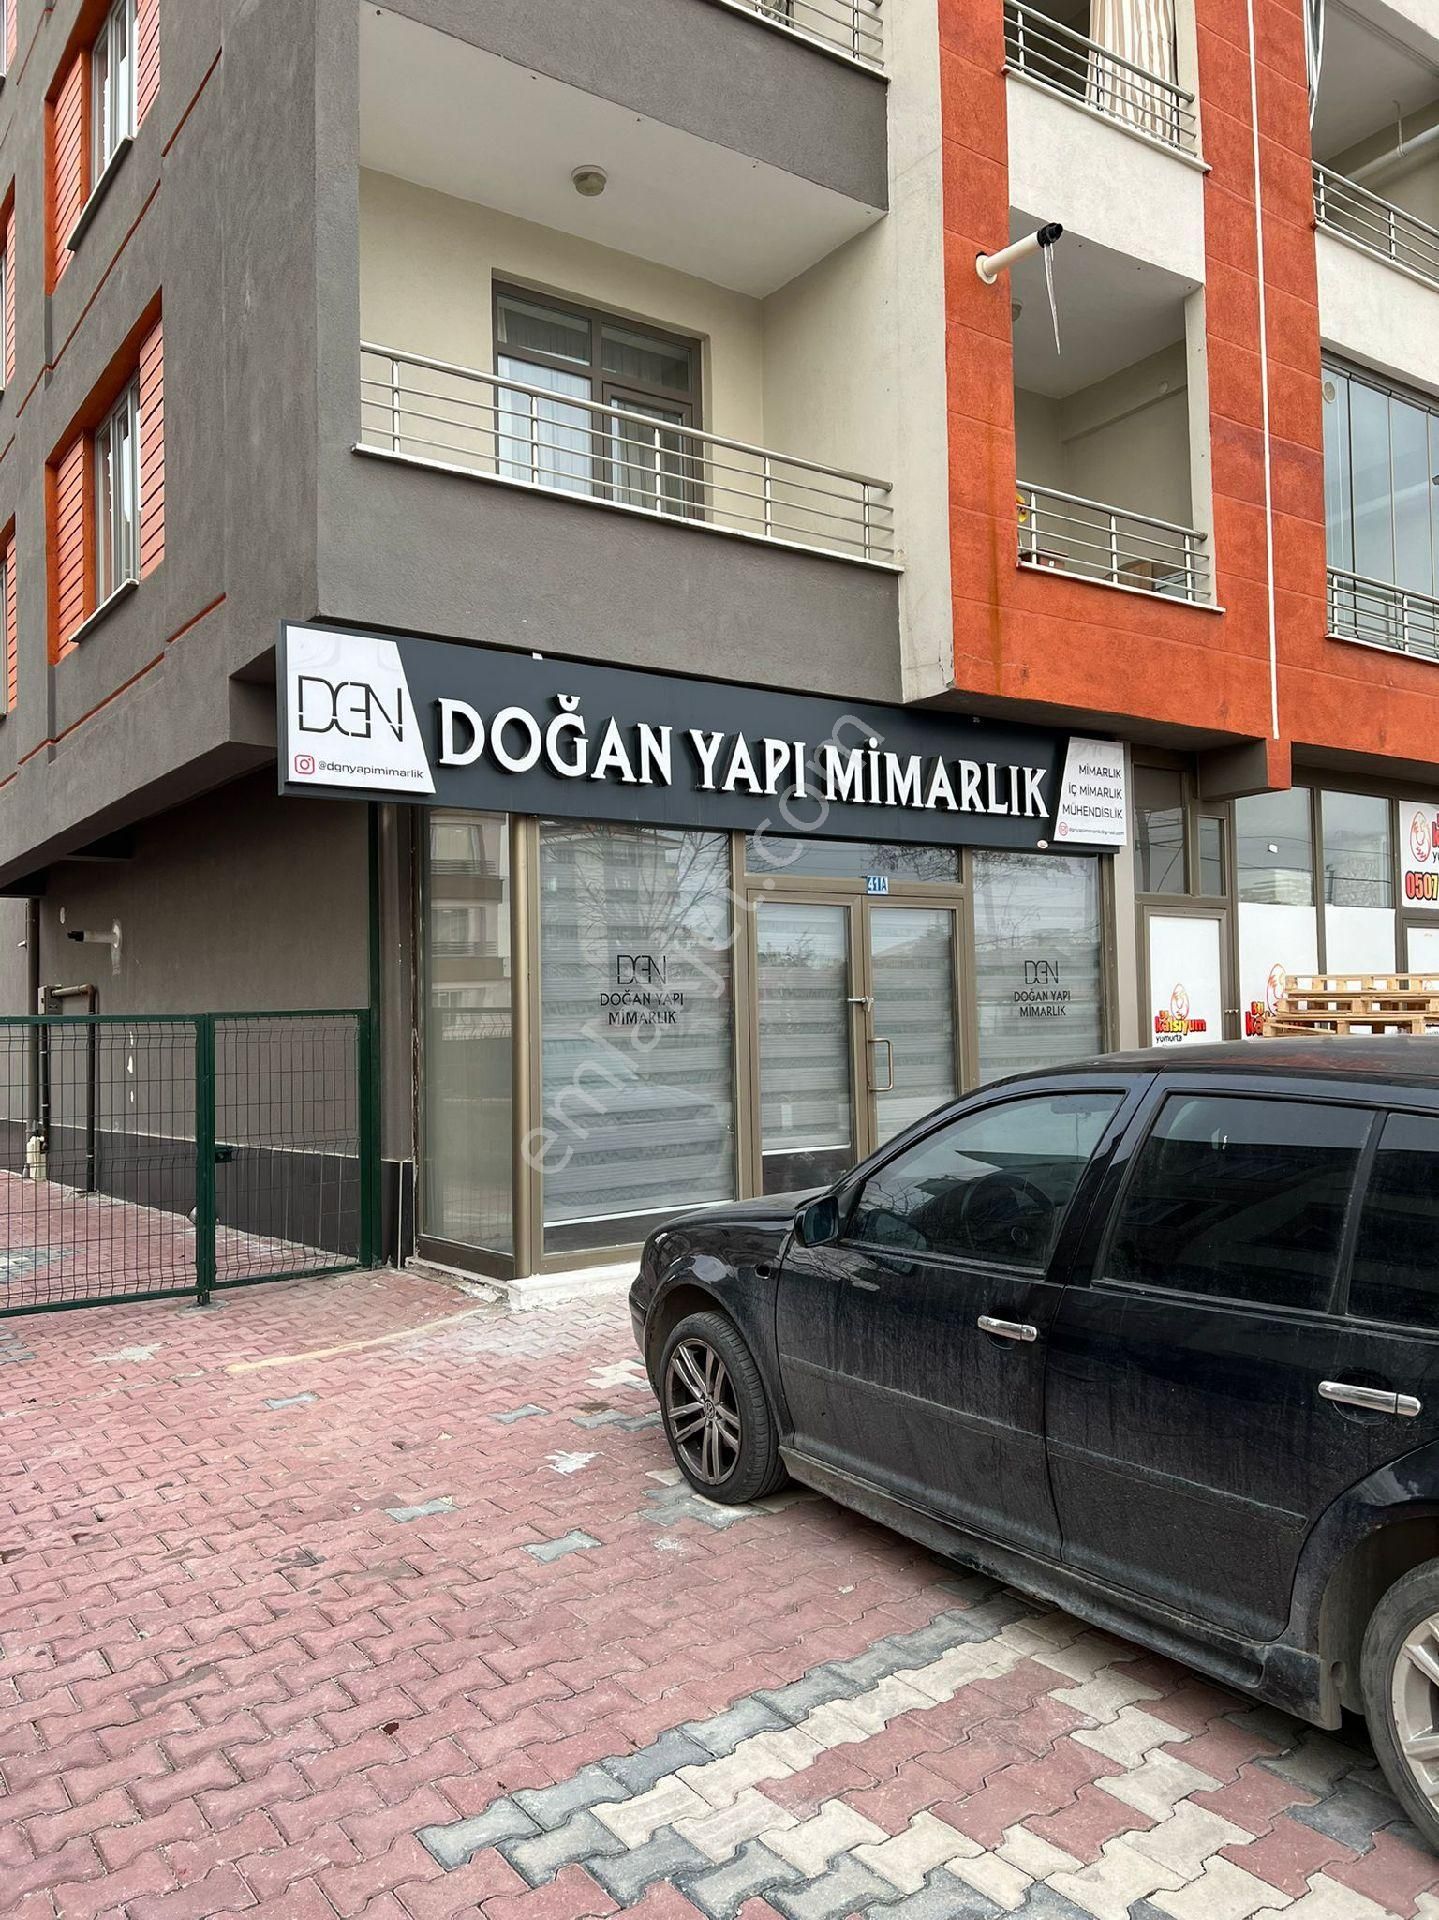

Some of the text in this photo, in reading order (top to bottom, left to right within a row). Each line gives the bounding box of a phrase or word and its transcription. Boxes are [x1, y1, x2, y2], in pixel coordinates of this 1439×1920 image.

[436, 692, 1050, 819] DOĞAN YAPI MİMARLIK
[1078, 762, 1122, 779] MİMARLIK
[1068, 782, 1122, 800] İÇ MİMARLIK
[1062, 802, 1123, 819] MÜHENDİSLİK
[600, 989, 684, 1006] DOĞAN YAPI
[1014, 987, 1071, 1002] DOĞAN YAPI
[1020, 1003, 1066, 1017] MİMARLIK
